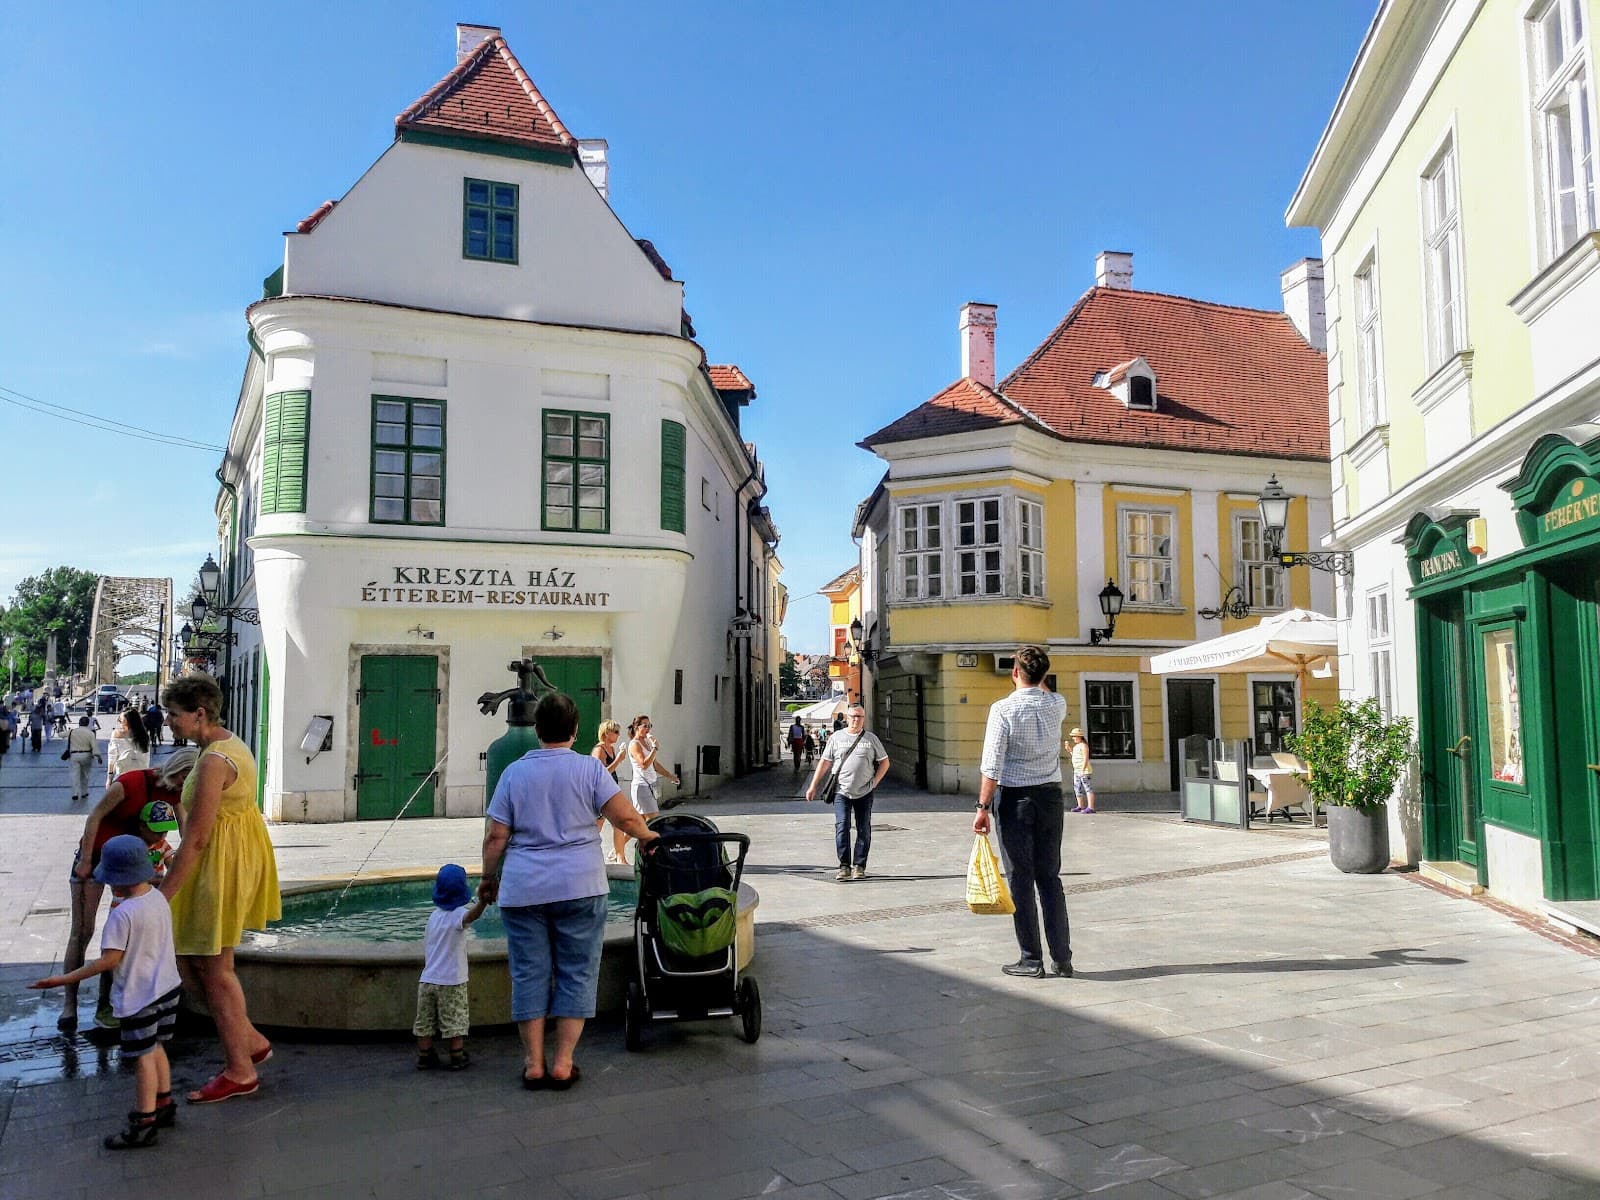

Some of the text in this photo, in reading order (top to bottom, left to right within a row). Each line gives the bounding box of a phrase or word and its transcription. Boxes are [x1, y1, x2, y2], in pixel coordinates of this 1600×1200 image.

[1545, 493, 1600, 532] FEHÉRNE
[393, 566, 576, 588] KRESZTA HÁZ
[361, 581, 610, 606] ÉTTEREM-RESTAURANT
